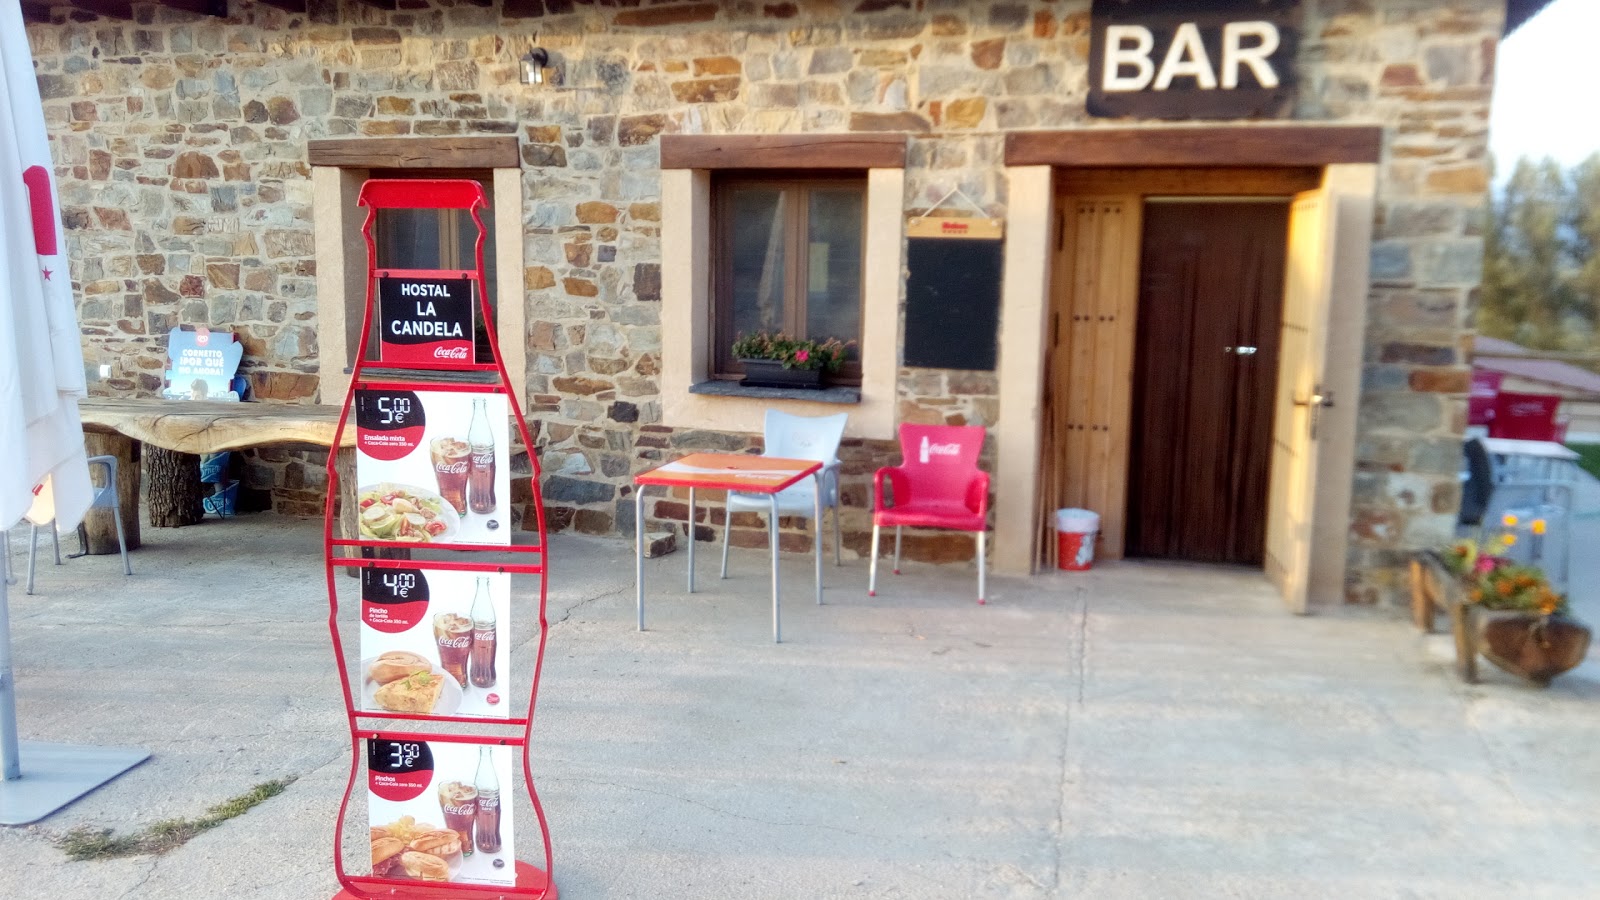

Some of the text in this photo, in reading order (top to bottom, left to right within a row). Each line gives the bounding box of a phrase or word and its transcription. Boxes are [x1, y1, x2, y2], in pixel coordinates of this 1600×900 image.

[1102, 21, 1280, 91] BAR
[401, 283, 451, 297] HOSTAL
[416, 301, 437, 316] LA
[391, 320, 463, 337] CANDELA
[182, 349, 223, 358] CORNETTO
[433, 346, 469, 359] Coca-Cola
[205, 356, 225, 368] QUÉ
[179, 366, 191, 375] NO
[436, 461, 468, 474] Coca-Cola
[438, 635, 470, 648] Coca-Cola
[444, 803, 475, 816] Coca-Cola
